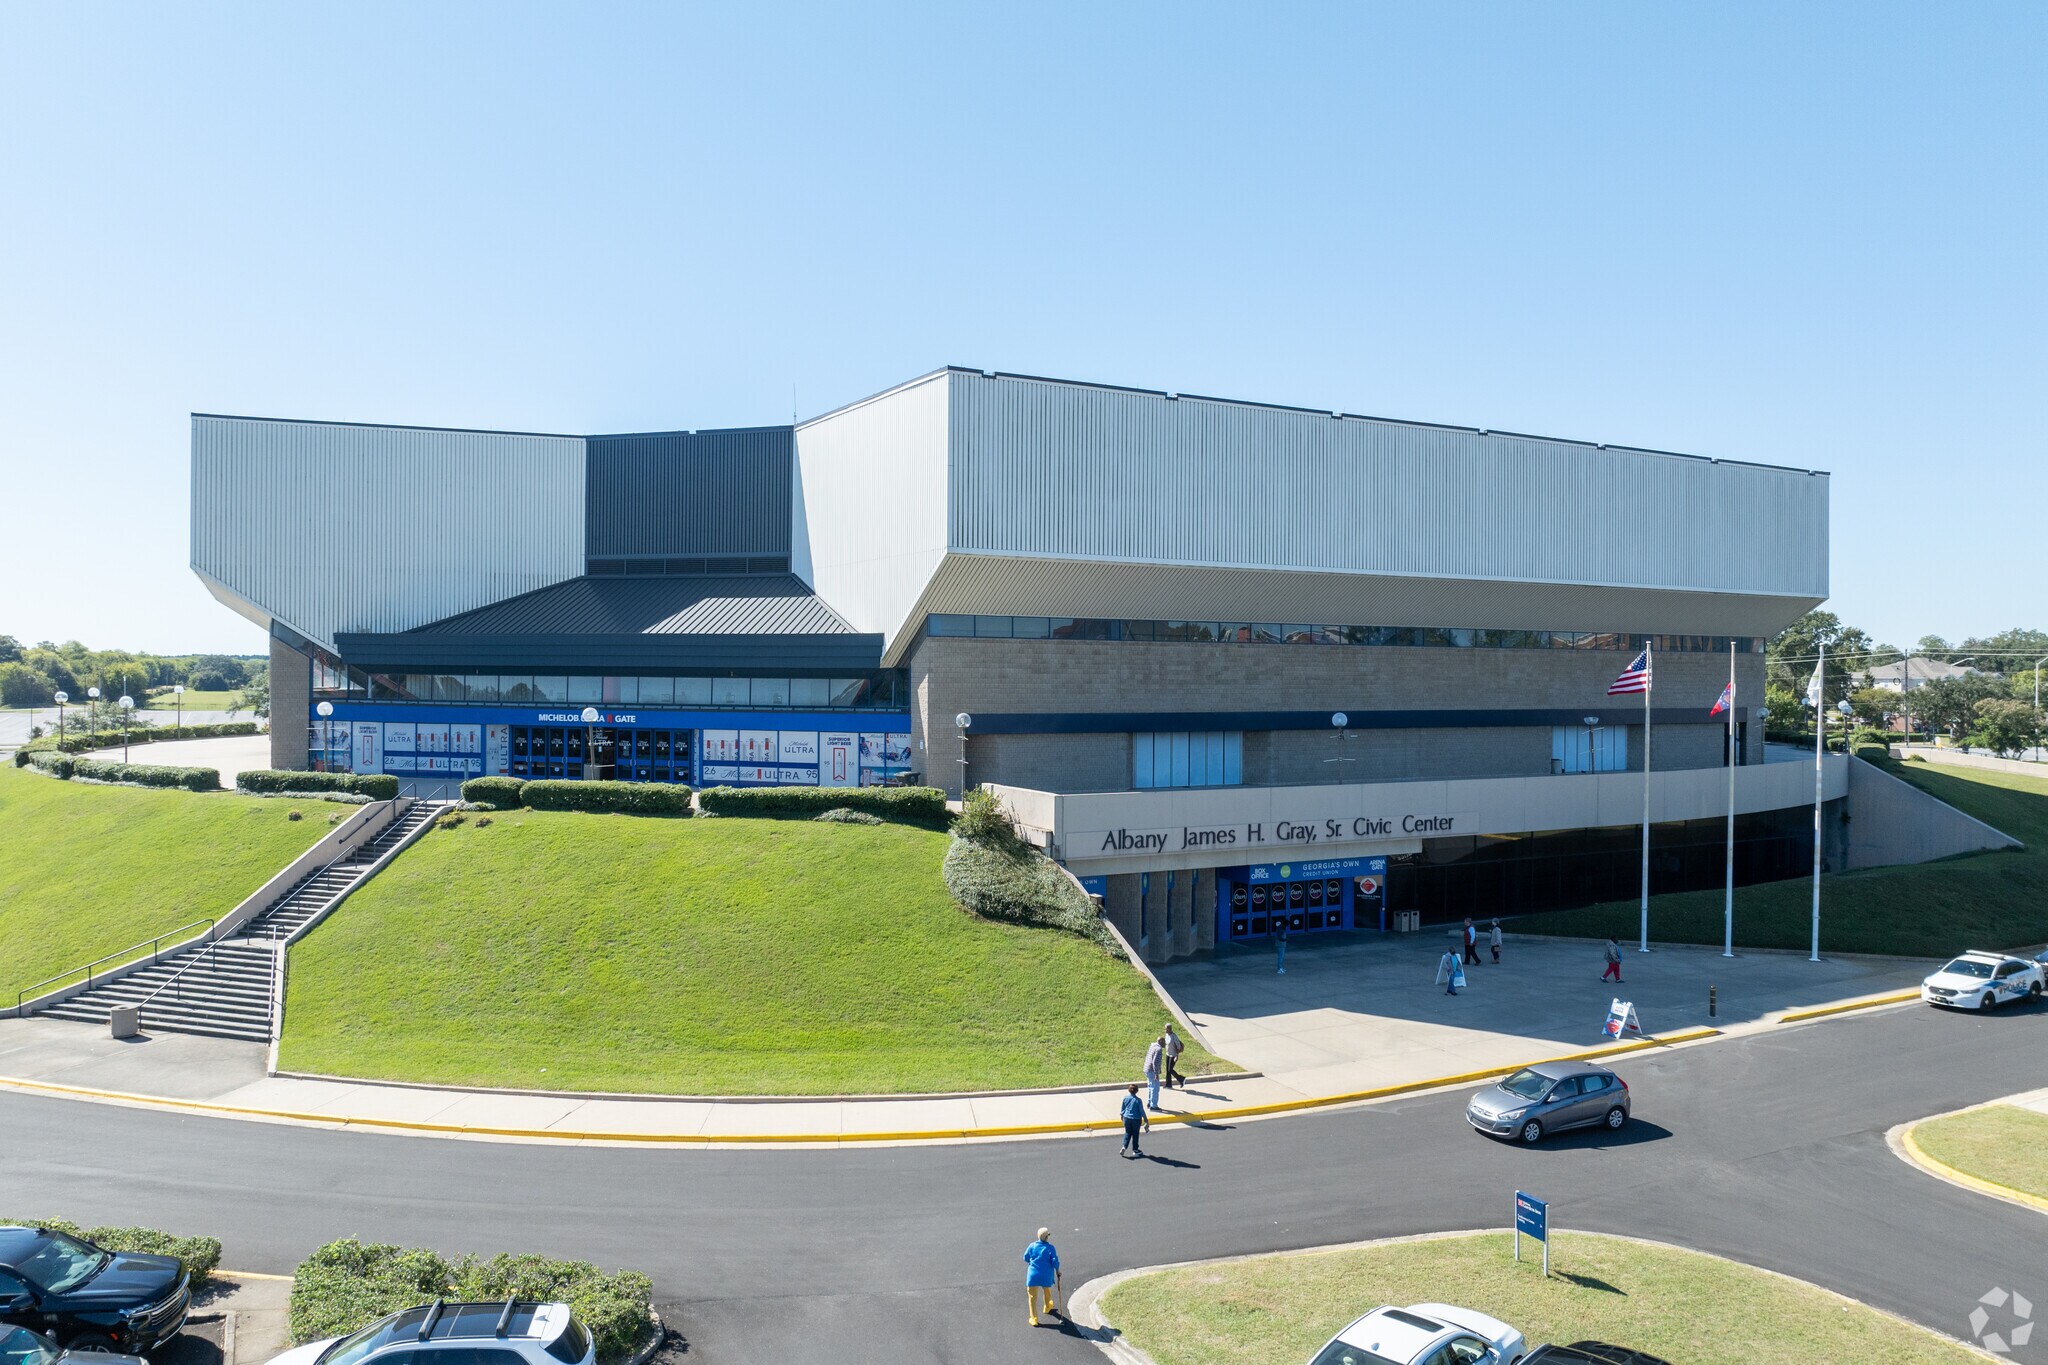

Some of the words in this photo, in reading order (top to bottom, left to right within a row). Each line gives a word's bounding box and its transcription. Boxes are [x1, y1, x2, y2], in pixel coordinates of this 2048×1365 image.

[538, 714, 579, 722] MICHELOB
[615, 715, 636, 723] GATE
[784, 746, 814, 754] ULTRA
[471, 759, 481, 767] 95
[806, 770, 818, 778] 95
[1101, 828, 1168, 853] Albany
[1181, 827, 1236, 849] James
[1248, 823, 1265, 842] H.
[1276, 821, 1317, 844] Gray,
[1326, 819, 1342, 837] Sr.
[1353, 817, 1392, 836] Civic
[1402, 814, 1454, 833] Center
[1303, 861, 1340, 871] GEORGIA'S
[1343, 860, 1360, 868] OWN
